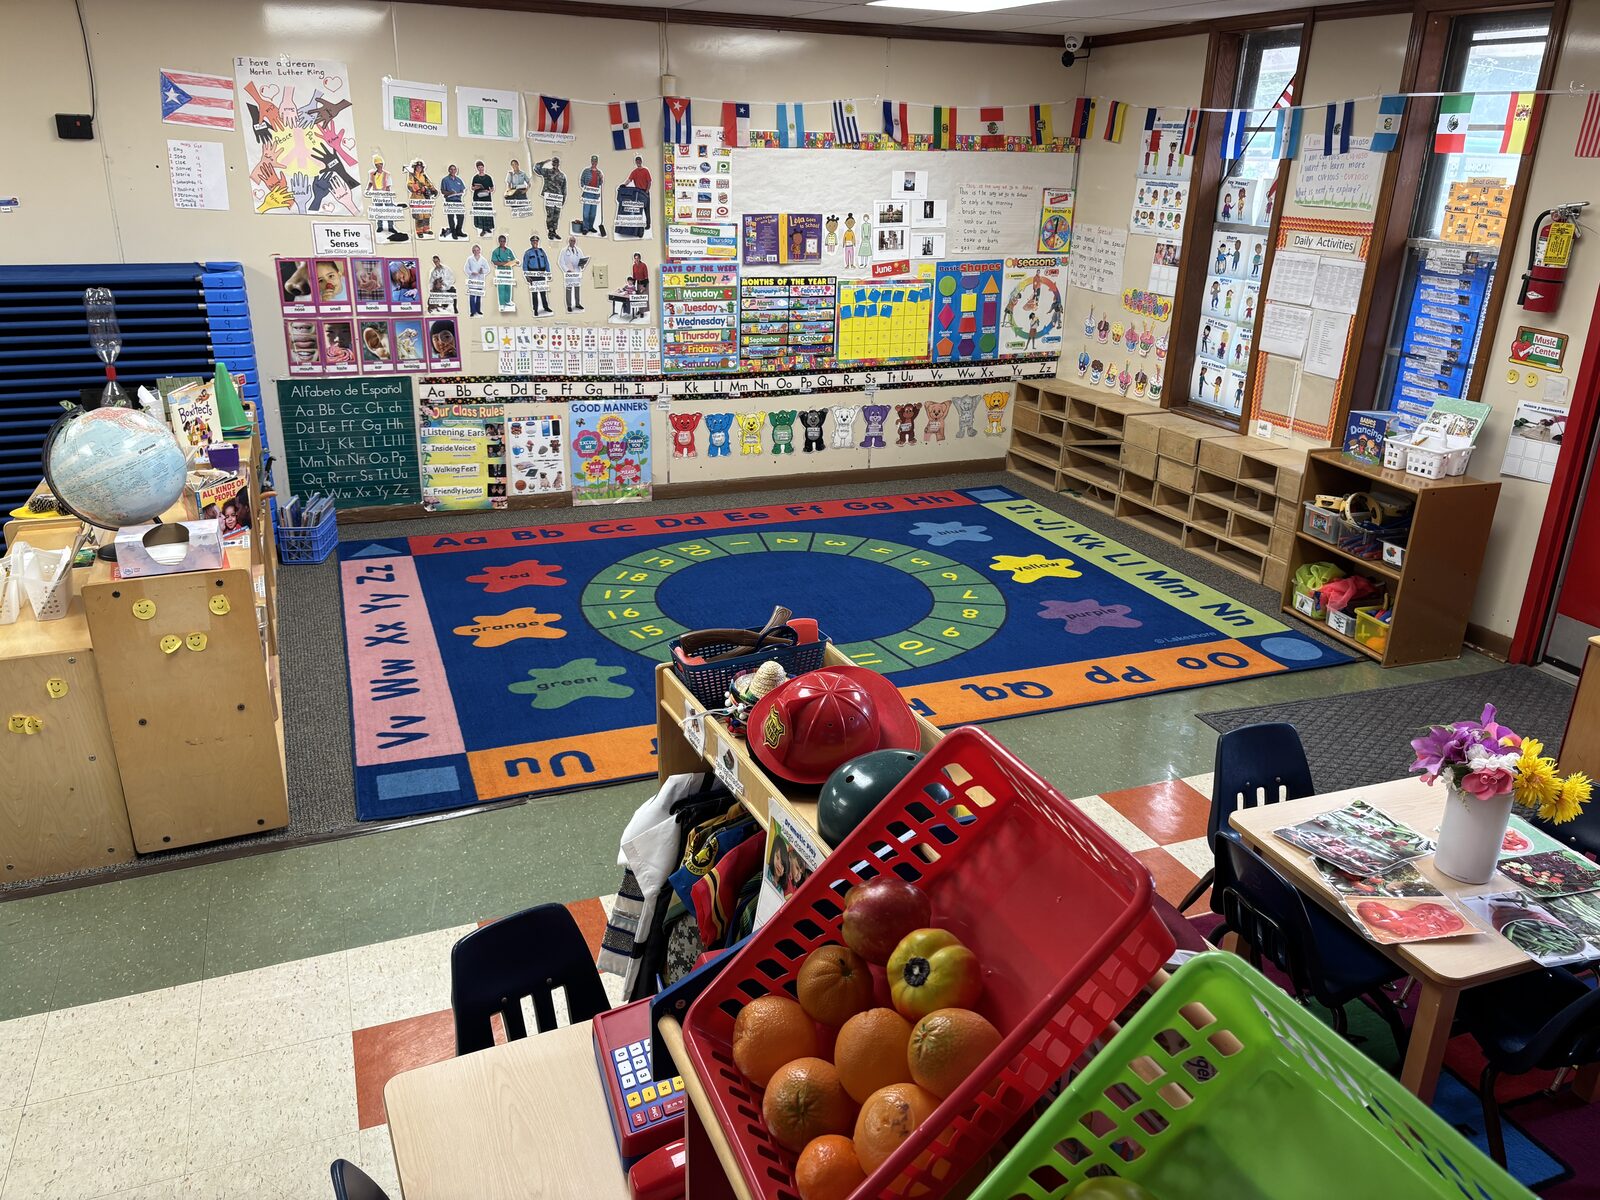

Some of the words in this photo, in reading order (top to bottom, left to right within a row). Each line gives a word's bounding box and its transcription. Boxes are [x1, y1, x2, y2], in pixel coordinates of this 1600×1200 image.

[237, 57, 244, 66] I
[249, 58, 269, 67] have
[286, 58, 316, 68] dream
[307, 69, 325, 79] King
[399, 121, 438, 131] CAMEROON
[274, 133, 292, 146] Peace
[325, 229, 341, 237] The
[344, 229, 360, 238] Five
[330, 240, 359, 248] Senses
[1294, 236, 1313, 246] Daily
[1317, 237, 1354, 251] Activities
[960, 263, 1001, 272] Shapes
[1017, 258, 1057, 268] seasons
[874, 265, 892, 274] June
[684, 275, 717, 285] Sunday
[683, 289, 718, 300] Monday
[683, 304, 718, 314] Tuesday
[676, 316, 725, 328] Wednesday
[681, 331, 719, 341] Thursday
[1535, 336, 1556, 346] Music
[688, 345, 714, 354] Friday
[1535, 346, 1559, 358] Center
[682, 359, 720, 369] Saturday
[1040, 363, 1051, 373] Zz
[931, 370, 943, 379] Vv
[958, 368, 976, 378] Ww
[981, 367, 994, 377] Xx
[1012, 365, 1023, 376] Yy
[817, 376, 832, 387] Qq
[843, 375, 854, 384] Rr
[865, 373, 876, 384] Ss
[887, 372, 896, 382] Tt
[901, 371, 914, 382] Uu
[684, 382, 698, 393] Kk
[730, 381, 748, 391] Mm
[754, 380, 769, 390] Nn
[776, 378, 792, 388] Oo
[801, 377, 812, 389] Pp
[291, 385, 341, 398] Alfabeto
[344, 384, 358, 396] de
[361, 382, 402, 398] Español
[428, 387, 445, 397] Aa
[456, 385, 472, 397] Bb
[483, 384, 499, 396] Cc
[510, 383, 528, 395] Dd
[534, 384, 548, 395] Ee
[561, 384, 573, 395] Ff
[585, 383, 602, 395] Gg
[613, 384, 629, 395] Hh
[635, 383, 645, 395] Ii
[659, 383, 669, 395] Jj
[178, 401, 213, 424] Boxitects
[432, 406, 450, 419] Our
[452, 405, 477, 417] Class
[479, 406, 504, 418] Rules
[571, 404, 601, 412] GOOD
[603, 402, 648, 412] MANNERS
[427, 428, 465, 437] Listening
[1350, 425, 1383, 443] Dancing
[433, 465, 461, 473] Walking
[202, 488, 215, 499] ALL
[215, 482, 235, 494] KINDS
[236, 479, 245, 487] OF
[214, 490, 236, 502] PEOPLE
[903, 495, 954, 506] Hh
[785, 505, 824, 516] Ff
[843, 500, 894, 511] Gg
[1005, 503, 1043, 515] Ii
[723, 510, 770, 522] Ee
[654, 516, 707, 529] Dd
[1033, 517, 1074, 532] Jj
[588, 523, 637, 535] Cc
[937, 527, 968, 537] blue
[511, 529, 565, 541] Bb
[432, 535, 488, 548] Aa
[1063, 532, 1106, 551] Kk
[678, 544, 712, 556] 20
[644, 556, 675, 567] 19
[1101, 552, 1148, 568] Ll
[1013, 560, 1060, 573] yellow
[356, 564, 396, 585] Zz
[500, 572, 530, 580] red
[616, 571, 648, 582] 18
[1136, 570, 1200, 599] Mm
[604, 589, 636, 600] 17
[359, 593, 410, 614] Yy
[607, 608, 640, 619] 16
[1065, 606, 1118, 622] purple
[1200, 601, 1255, 628] Nn
[470, 619, 540, 634] orange
[629, 624, 664, 640] 15
[363, 621, 410, 647] Xx
[898, 640, 936, 656] 10
[1176, 651, 1250, 670] Oo
[369, 659, 421, 702] Ww
[1084, 665, 1156, 685] Pp
[536, 675, 599, 692] green
[960, 681, 1053, 702] Qq
[375, 715, 430, 750] Vv
[504, 750, 596, 778] Uu
